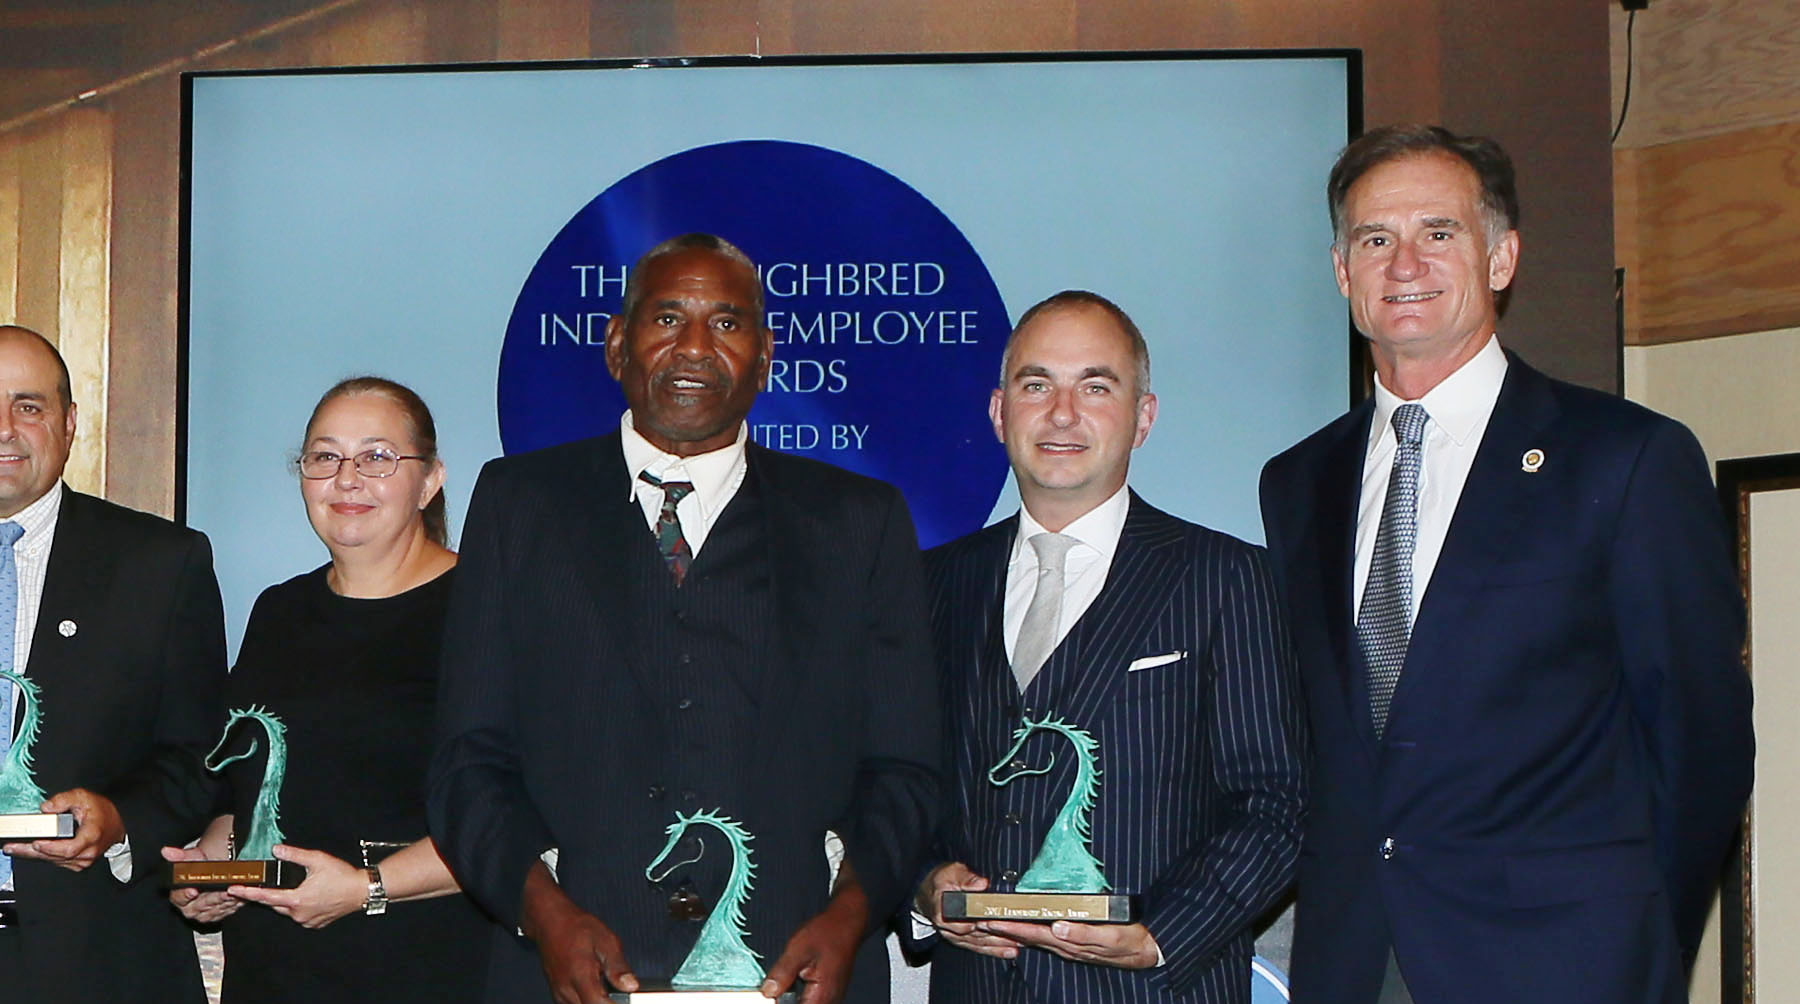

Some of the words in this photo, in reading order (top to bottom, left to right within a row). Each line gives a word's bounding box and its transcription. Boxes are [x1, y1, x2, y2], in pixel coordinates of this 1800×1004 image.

[571, 263, 945, 297] THGHBRED
[767, 311, 978, 344] EMPLOYEE
[766, 359, 848, 393] RDS
[832, 424, 869, 449] BY
